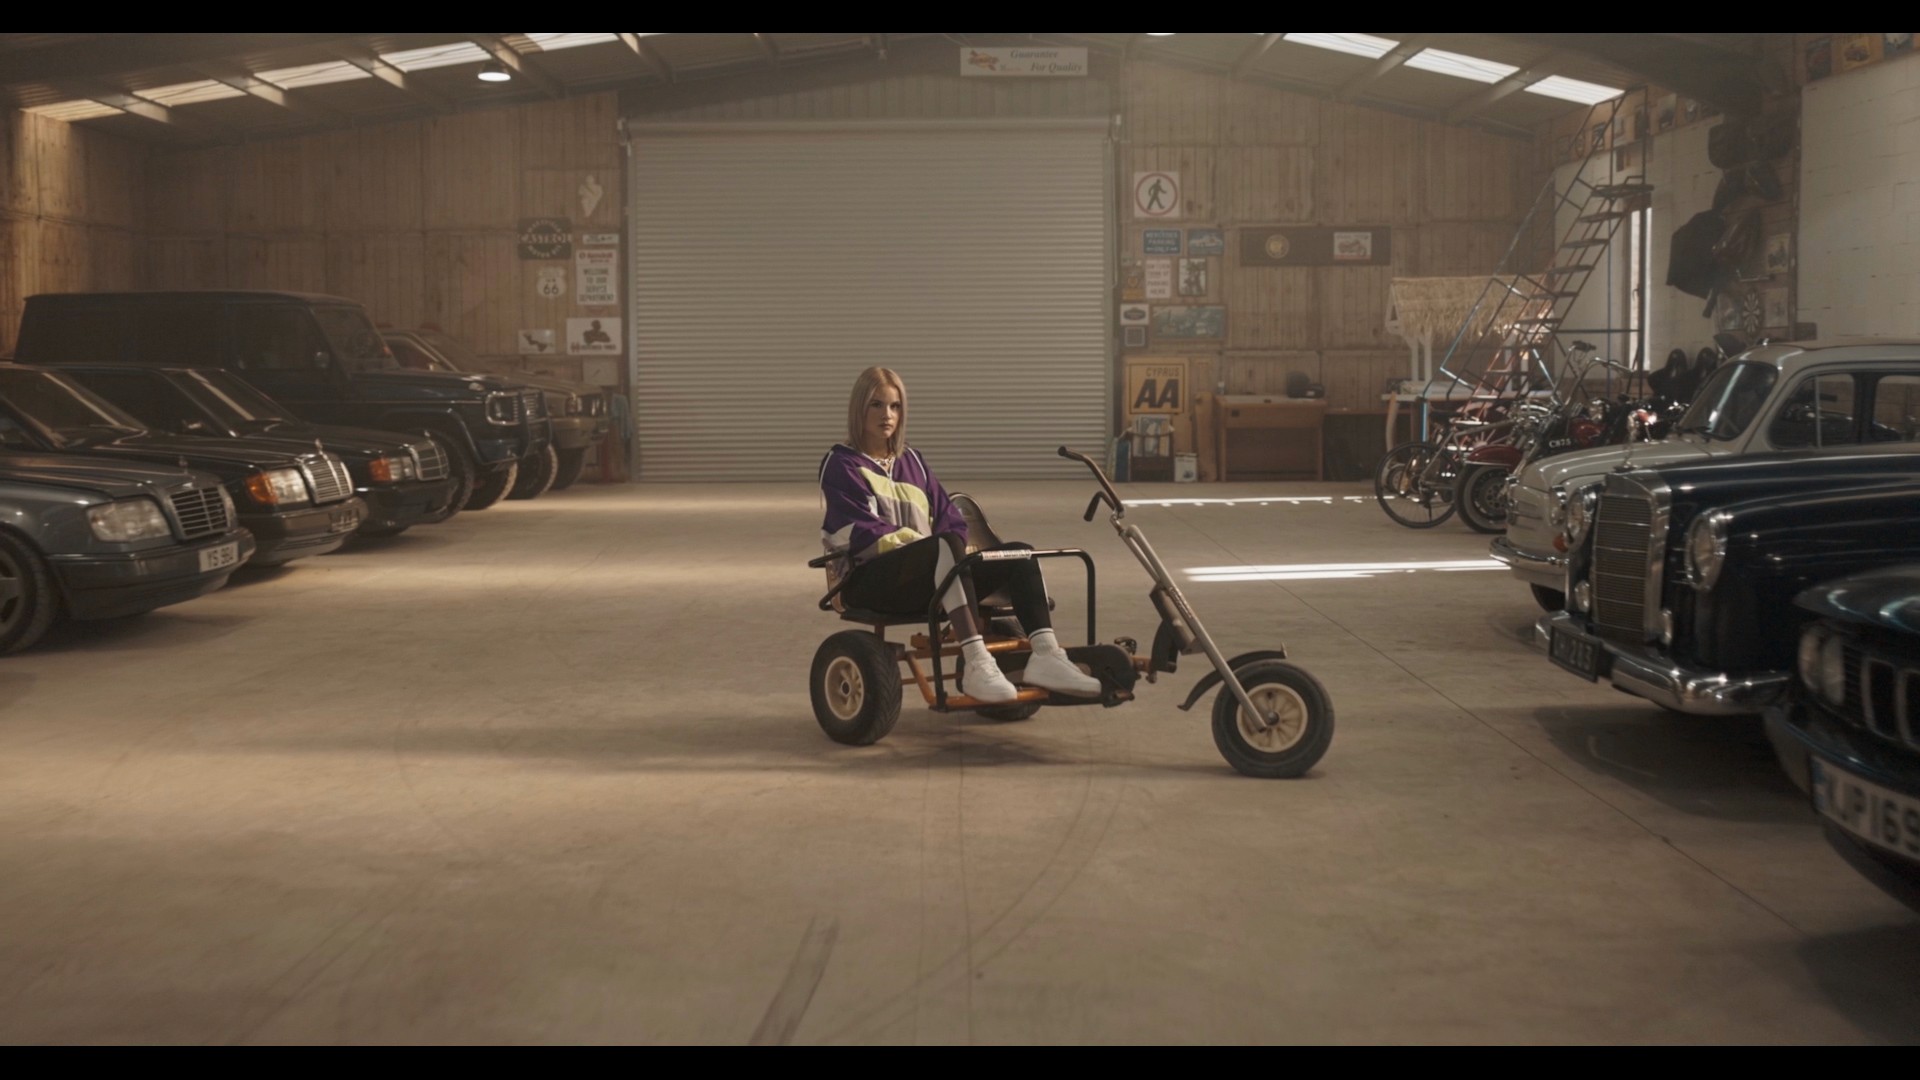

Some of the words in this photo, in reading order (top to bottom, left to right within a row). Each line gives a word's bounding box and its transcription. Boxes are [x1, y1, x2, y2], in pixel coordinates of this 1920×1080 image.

[1010, 49, 1058, 59] Guarantee
[1030, 62, 1046, 72] For
[1048, 62, 1082, 73] Quality
[517, 233, 573, 244] CASTROL
[543, 284, 559, 295] 66
[1145, 367, 1180, 377] CYPRUS
[1133, 378, 1179, 409] AA
